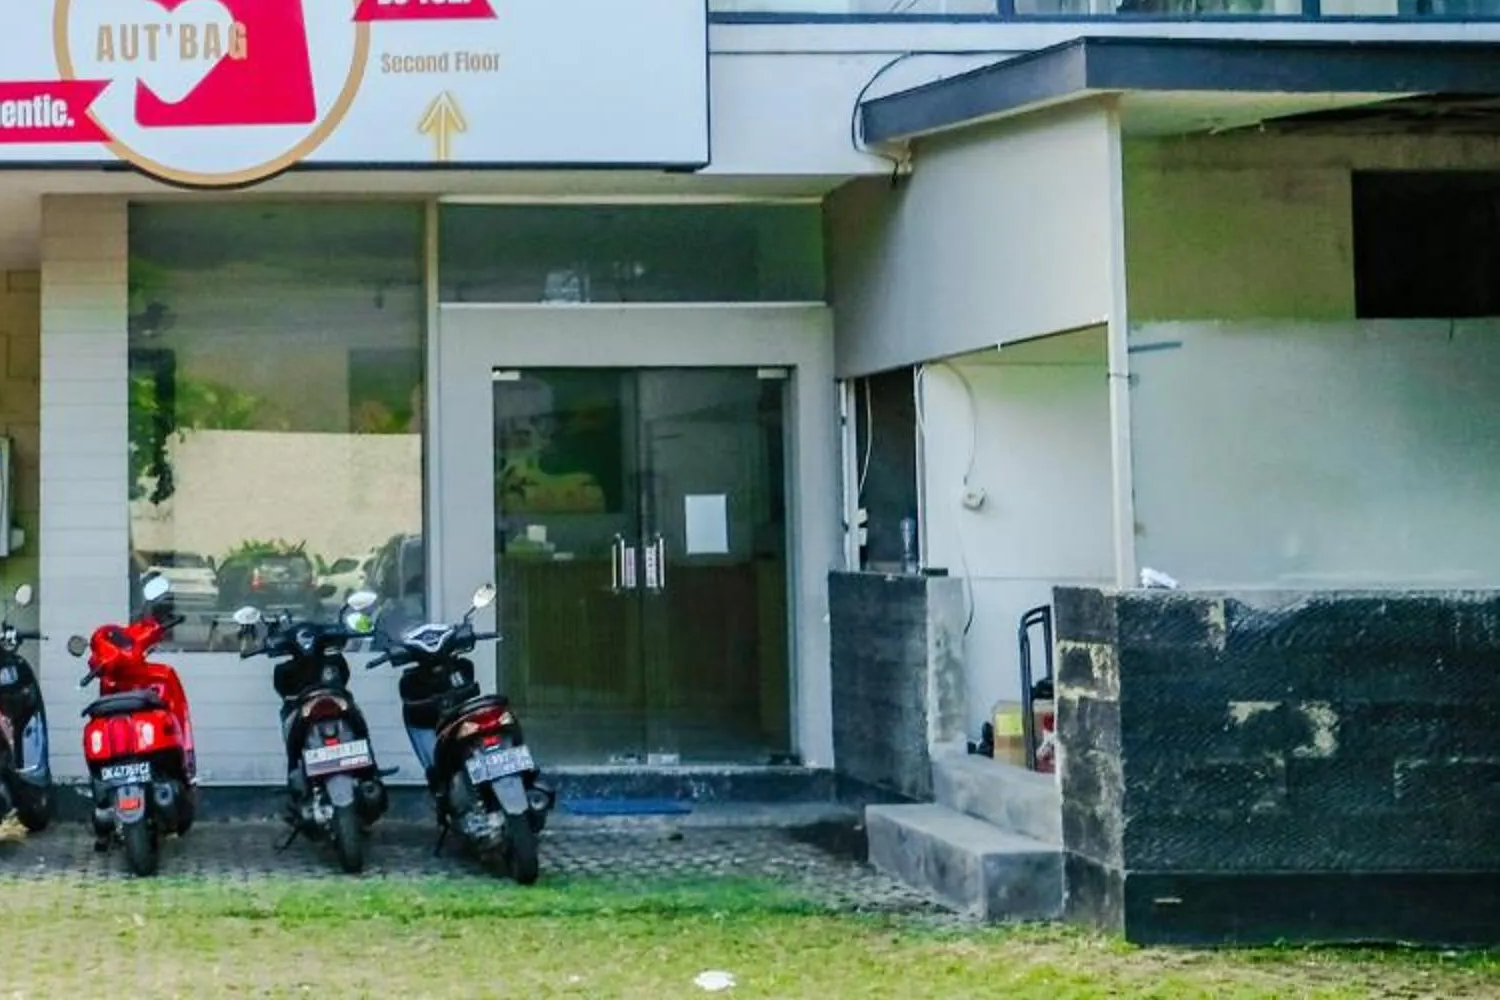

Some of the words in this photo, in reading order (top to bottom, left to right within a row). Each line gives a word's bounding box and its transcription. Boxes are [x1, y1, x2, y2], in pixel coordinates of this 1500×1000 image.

[96, 20, 249, 62] AUT'BAG
[380, 51, 450, 74] Second
[454, 49, 500, 74] Floor
